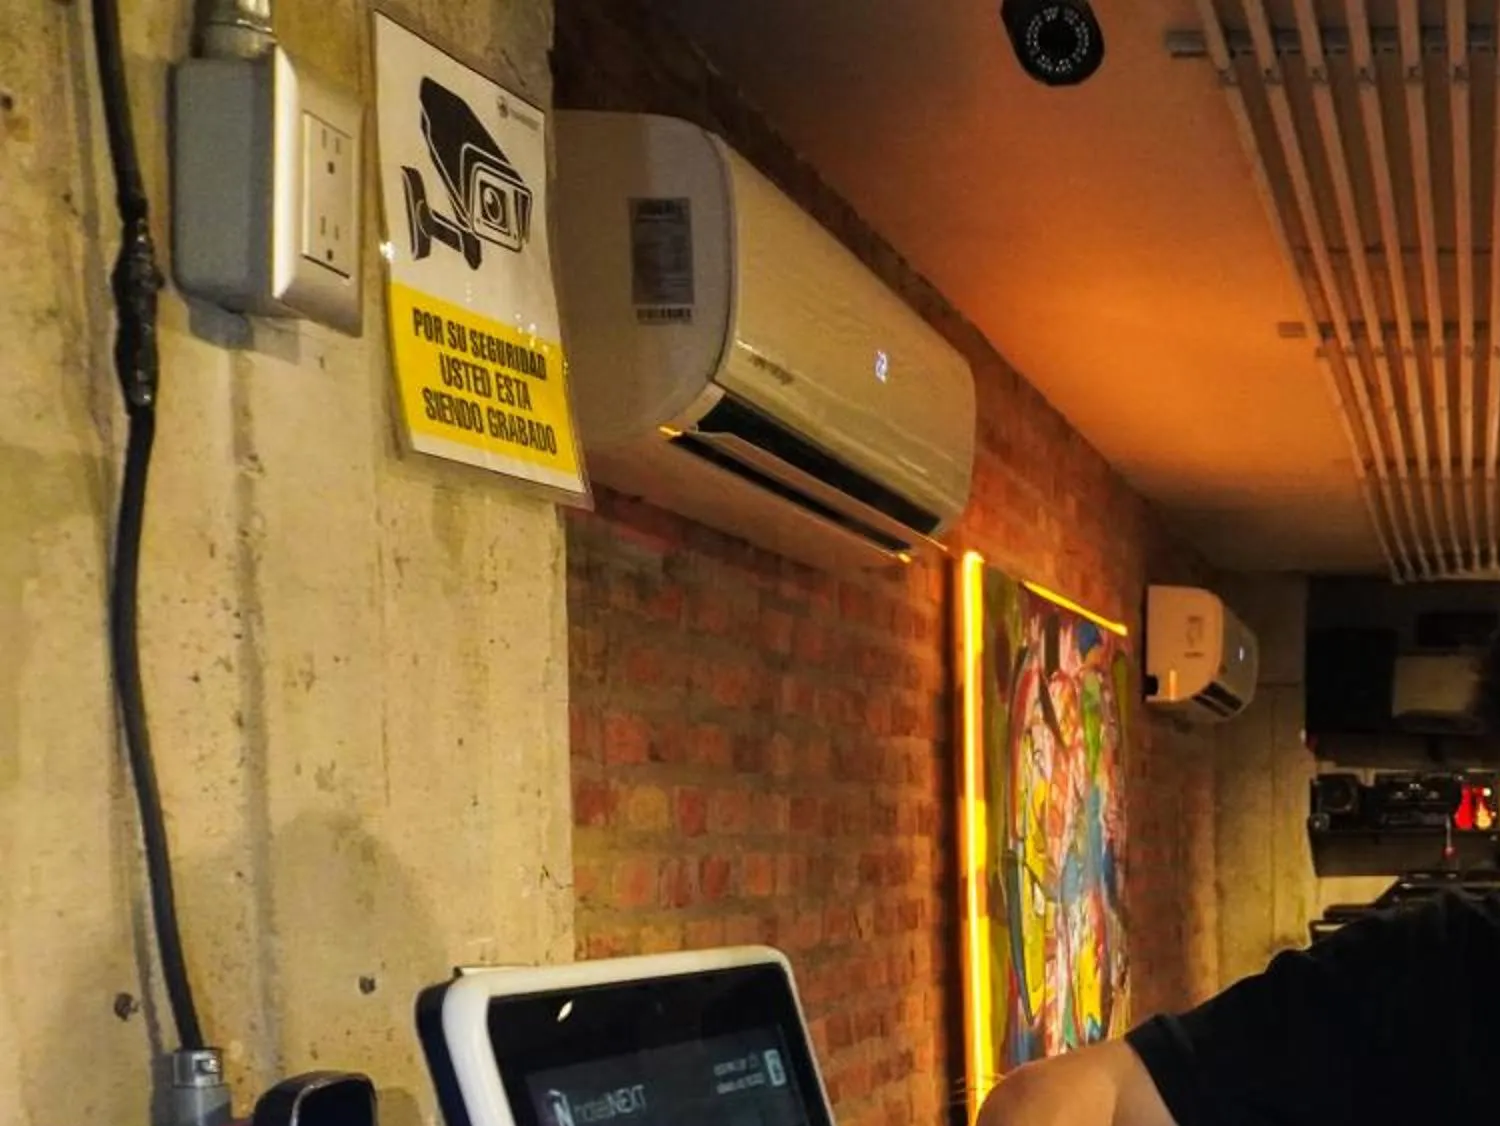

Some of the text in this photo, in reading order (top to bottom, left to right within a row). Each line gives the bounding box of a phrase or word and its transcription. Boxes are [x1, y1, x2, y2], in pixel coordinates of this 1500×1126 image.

[412, 307, 548, 381] POR SU SEGURIDAD
[438, 352, 534, 412] USTED ESTA
[421, 386, 558, 455] SIENDO GRABADO
